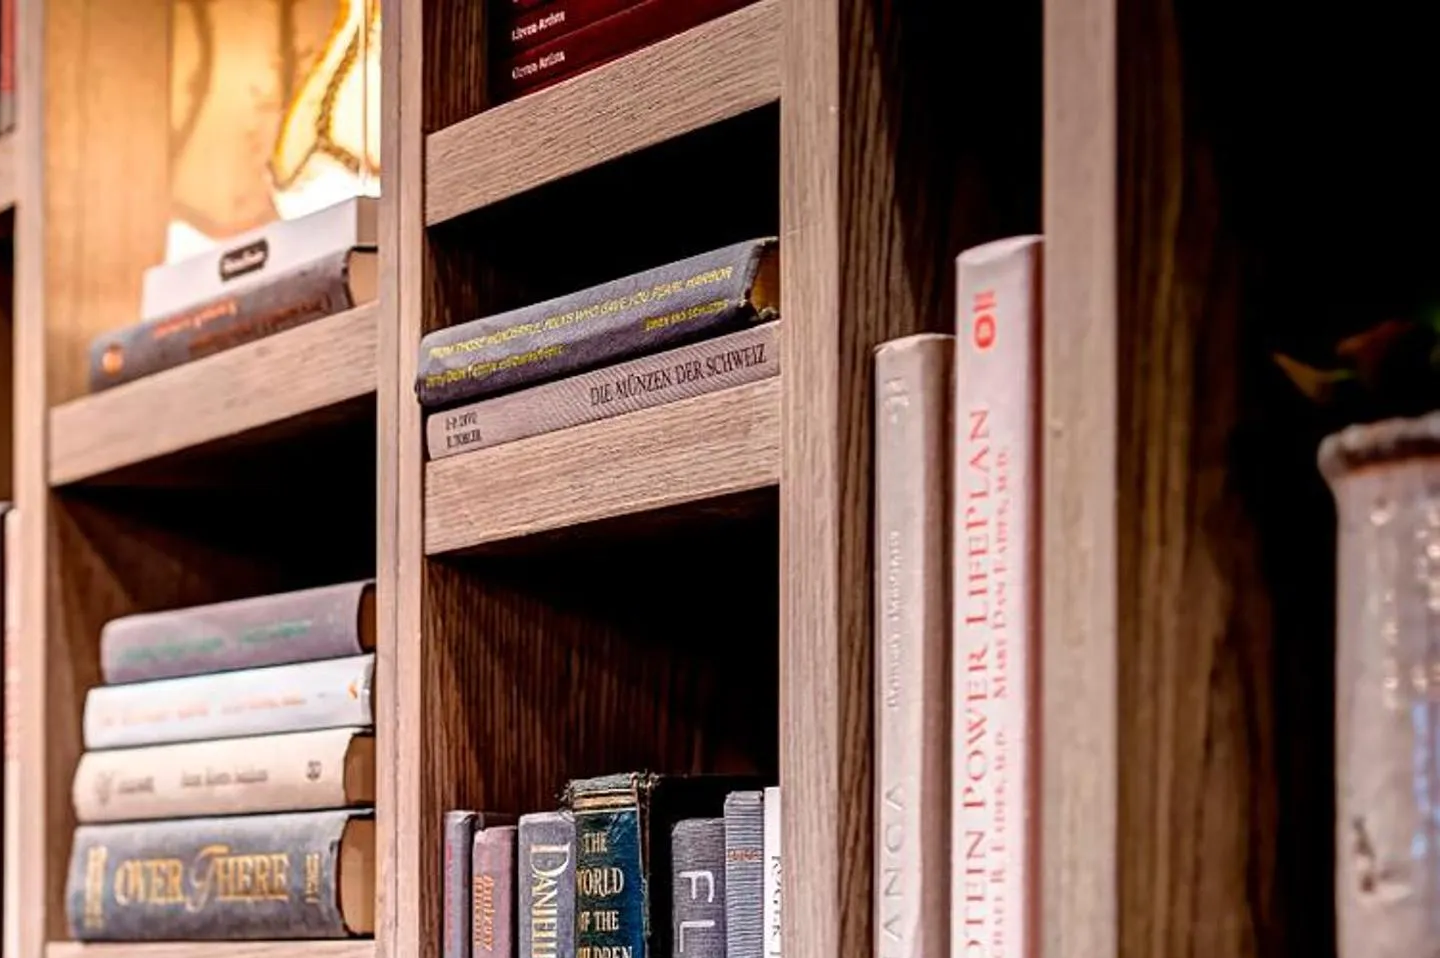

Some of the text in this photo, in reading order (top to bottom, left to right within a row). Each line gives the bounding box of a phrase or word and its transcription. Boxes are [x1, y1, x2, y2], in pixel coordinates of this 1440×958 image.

[589, 343, 767, 407] DIE MÜNZEN DER SCHWEIZ
[961, 644, 989, 810] POWER
[582, 830, 608, 854] THE
[113, 858, 186, 906] OVER
[186, 844, 290, 913] THERE
[593, 909, 620, 932] THE
